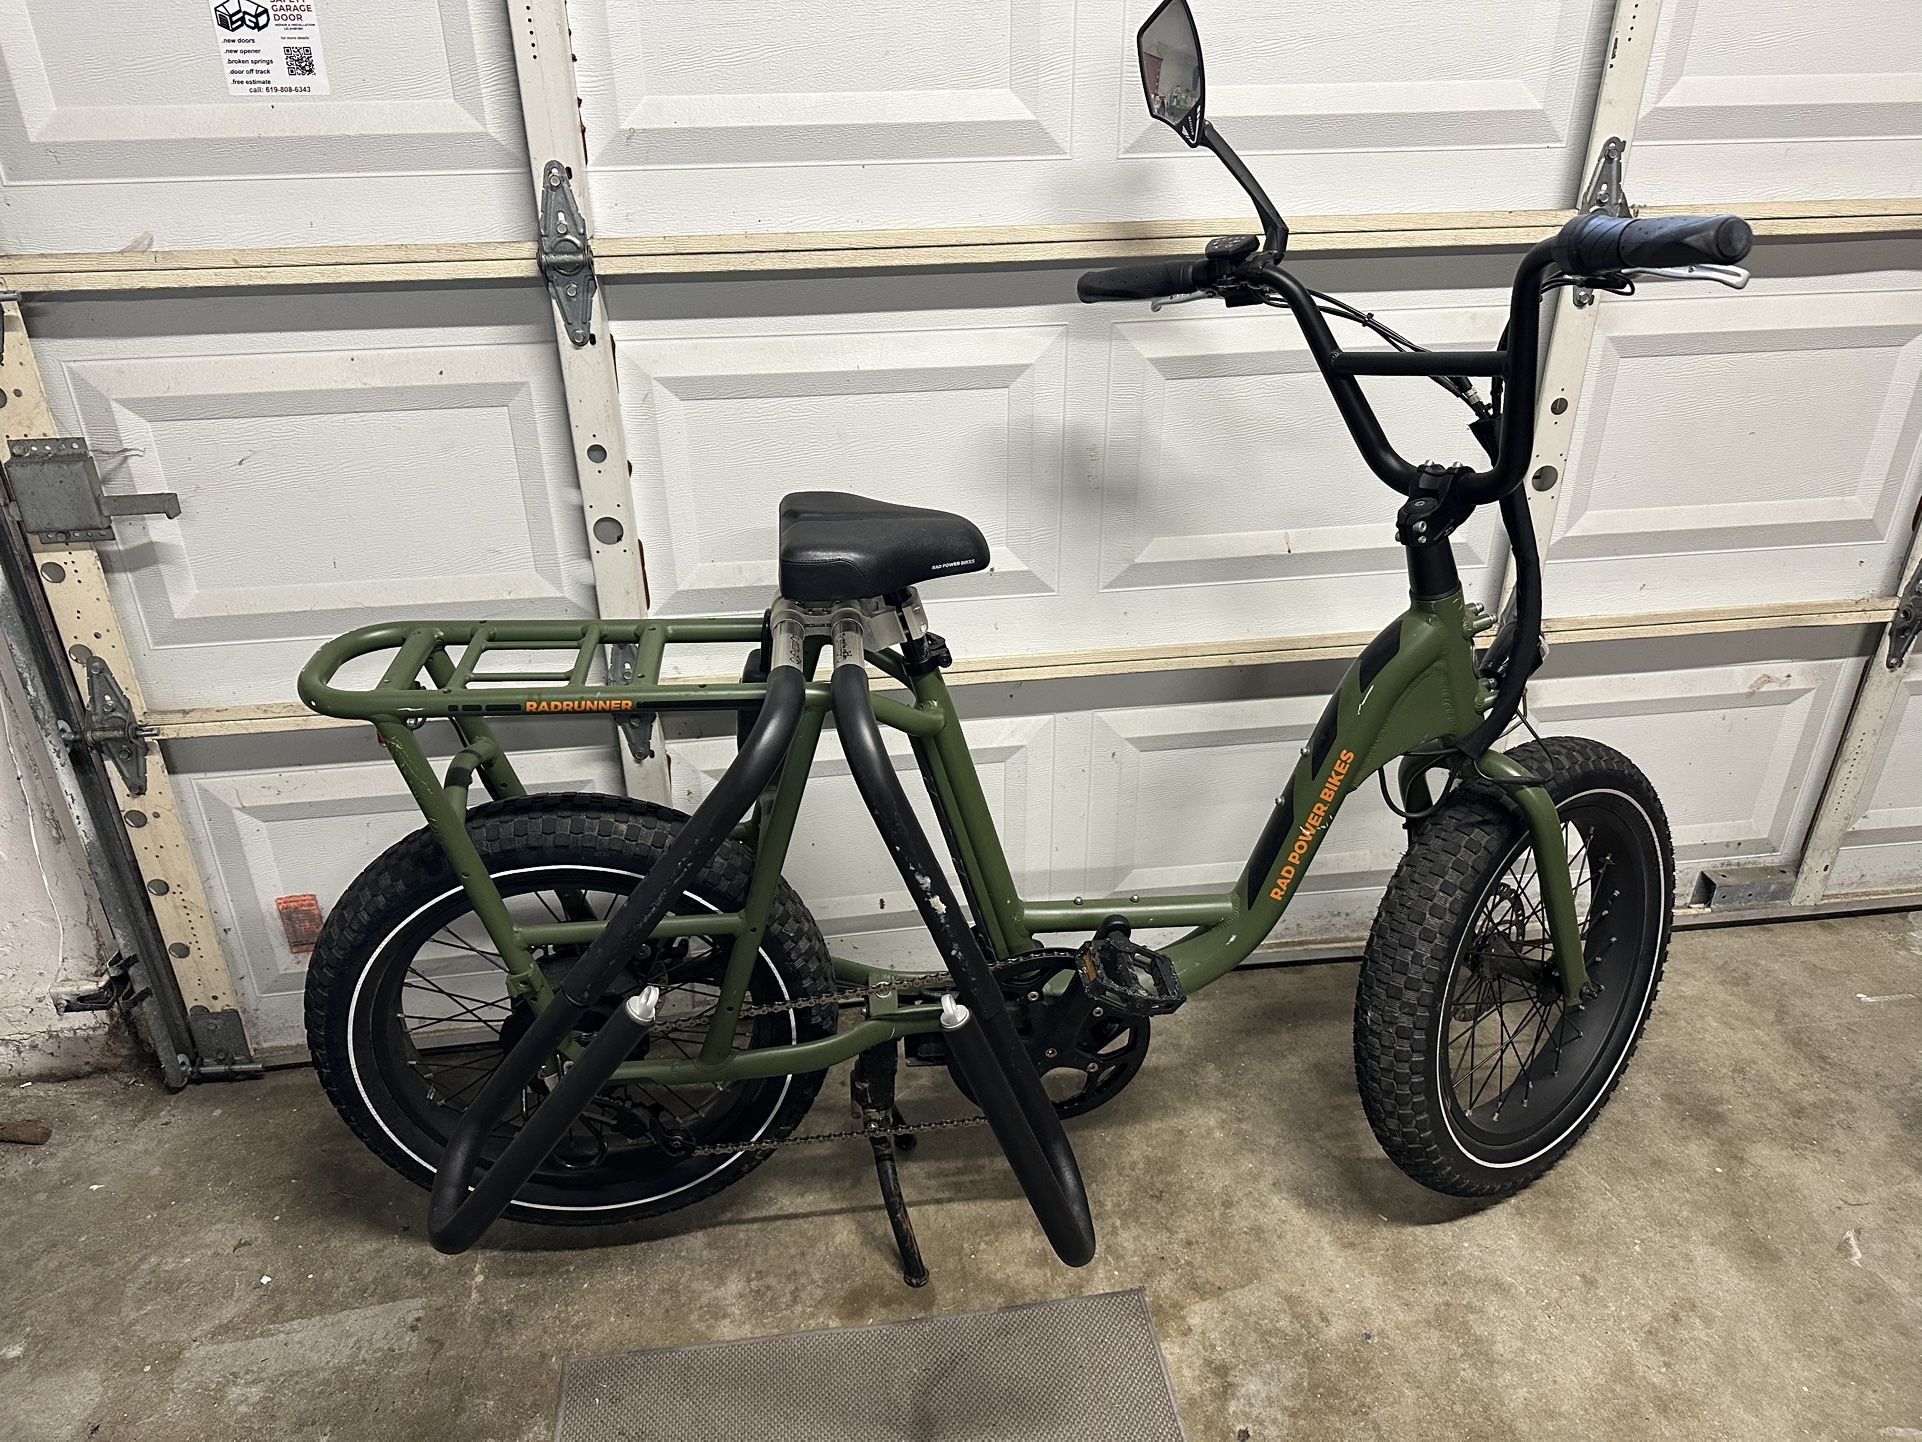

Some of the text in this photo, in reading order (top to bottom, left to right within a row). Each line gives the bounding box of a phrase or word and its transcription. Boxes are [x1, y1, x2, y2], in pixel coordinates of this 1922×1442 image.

[271, 4, 312, 12] GARAGE
[273, 13, 303, 21] DOOR
[525, 700, 633, 712] RADRUNNER
[1269, 749, 1355, 901] RAD POWER BIKES
